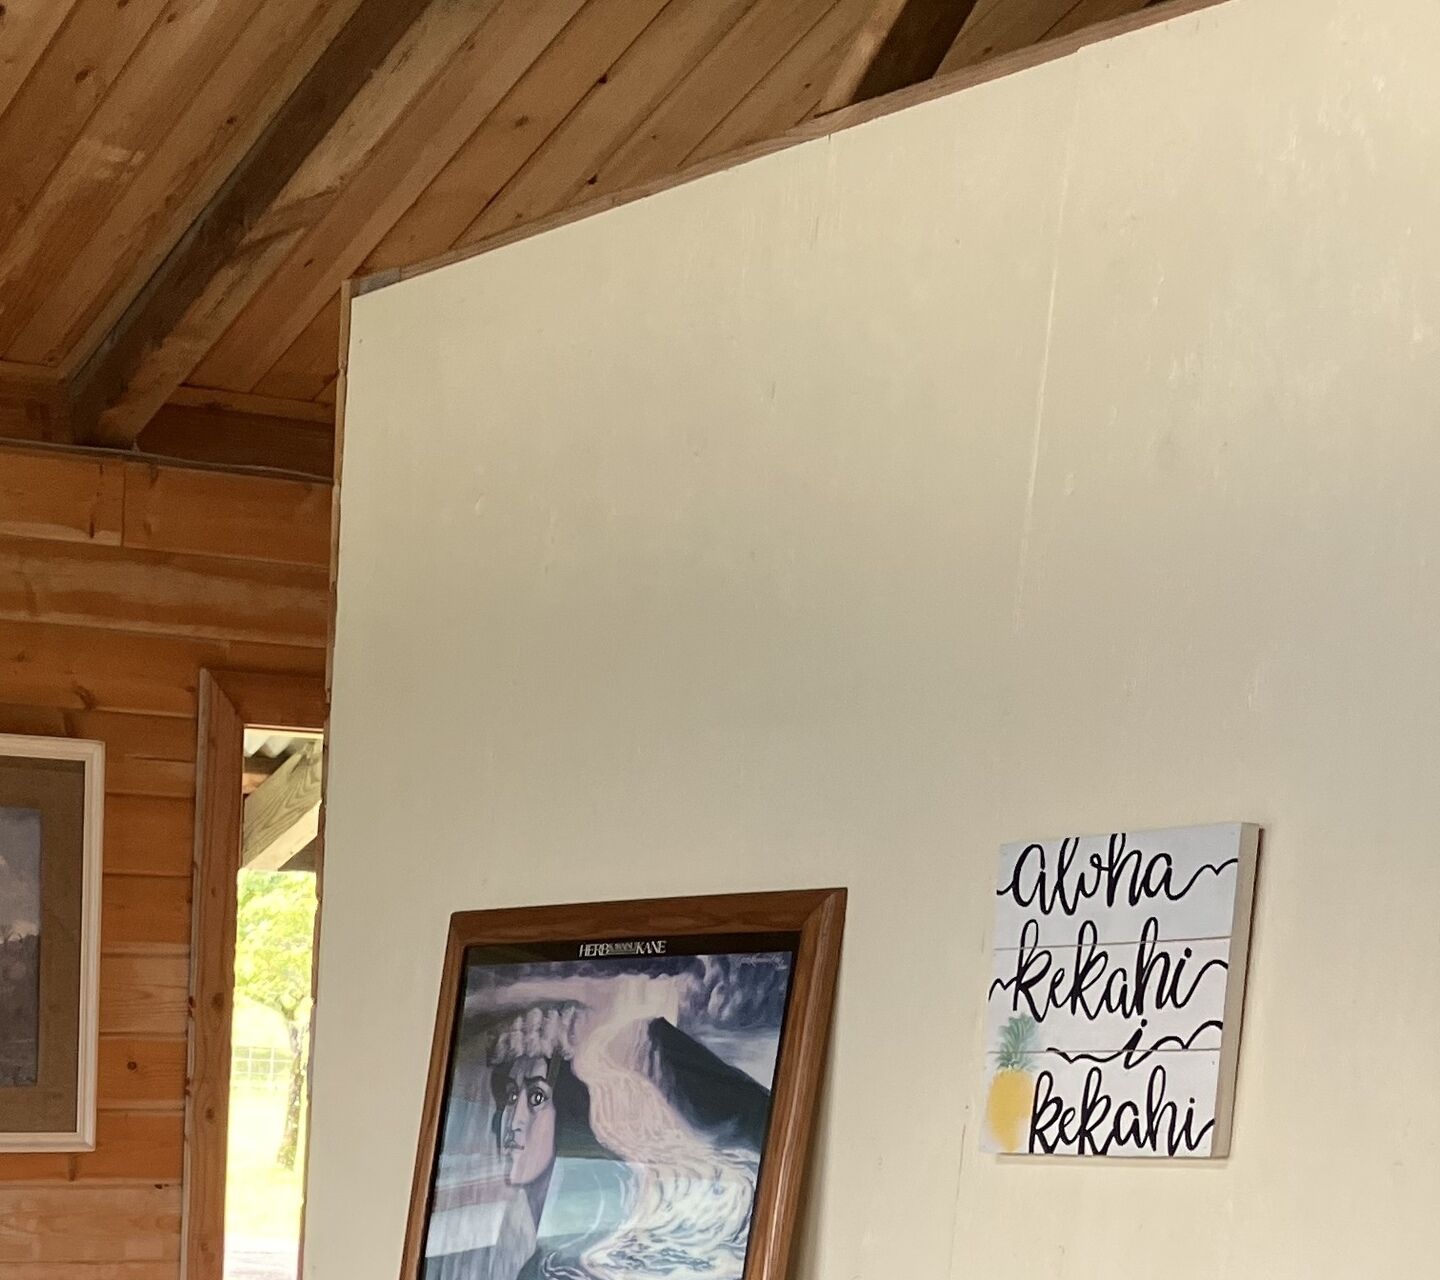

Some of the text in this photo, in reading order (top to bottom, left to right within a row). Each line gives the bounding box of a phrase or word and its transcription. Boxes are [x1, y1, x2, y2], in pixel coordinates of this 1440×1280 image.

[996, 832, 1239, 915] aloha
[988, 917, 1229, 1023] kekahi
[1028, 1065, 1216, 1157] kekahi
